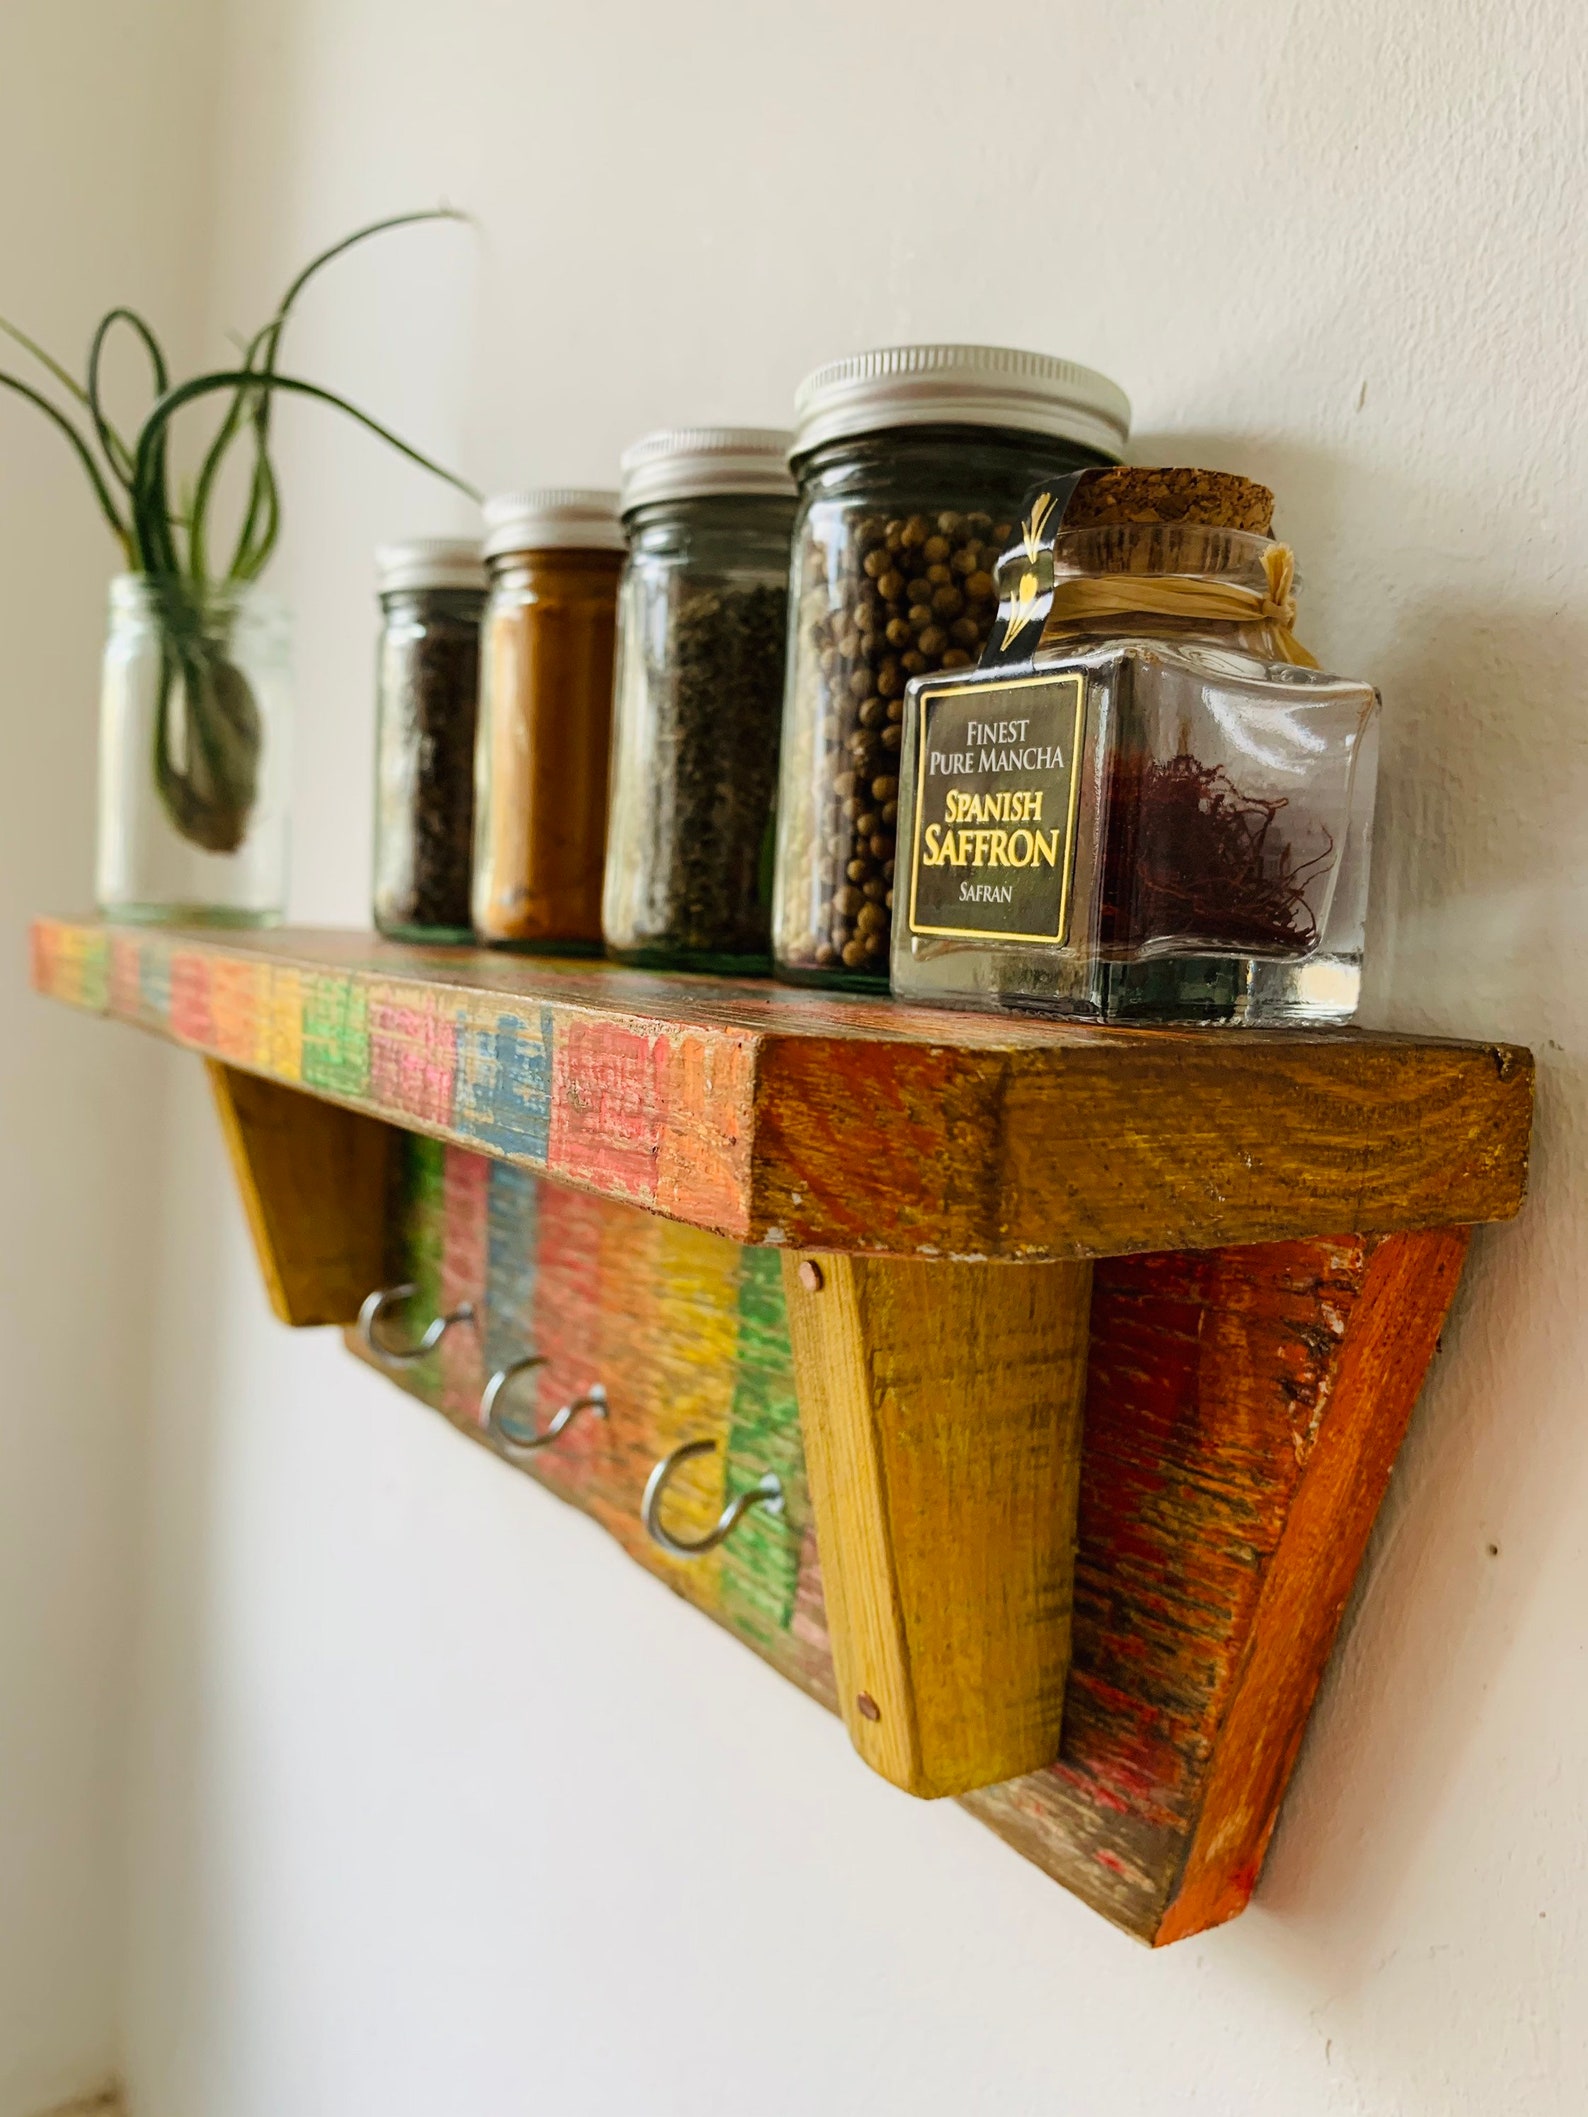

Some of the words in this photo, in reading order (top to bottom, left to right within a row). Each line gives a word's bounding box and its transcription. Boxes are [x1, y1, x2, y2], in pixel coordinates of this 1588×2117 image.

[966, 719, 1030, 746] FINEST
[929, 751, 974, 776] PURE
[978, 746, 1064, 773] MANCHA
[944, 788, 1043, 823] SPANISH
[922, 823, 1060, 868] SAFFRON
[958, 881, 1013, 903] SAFRAN
